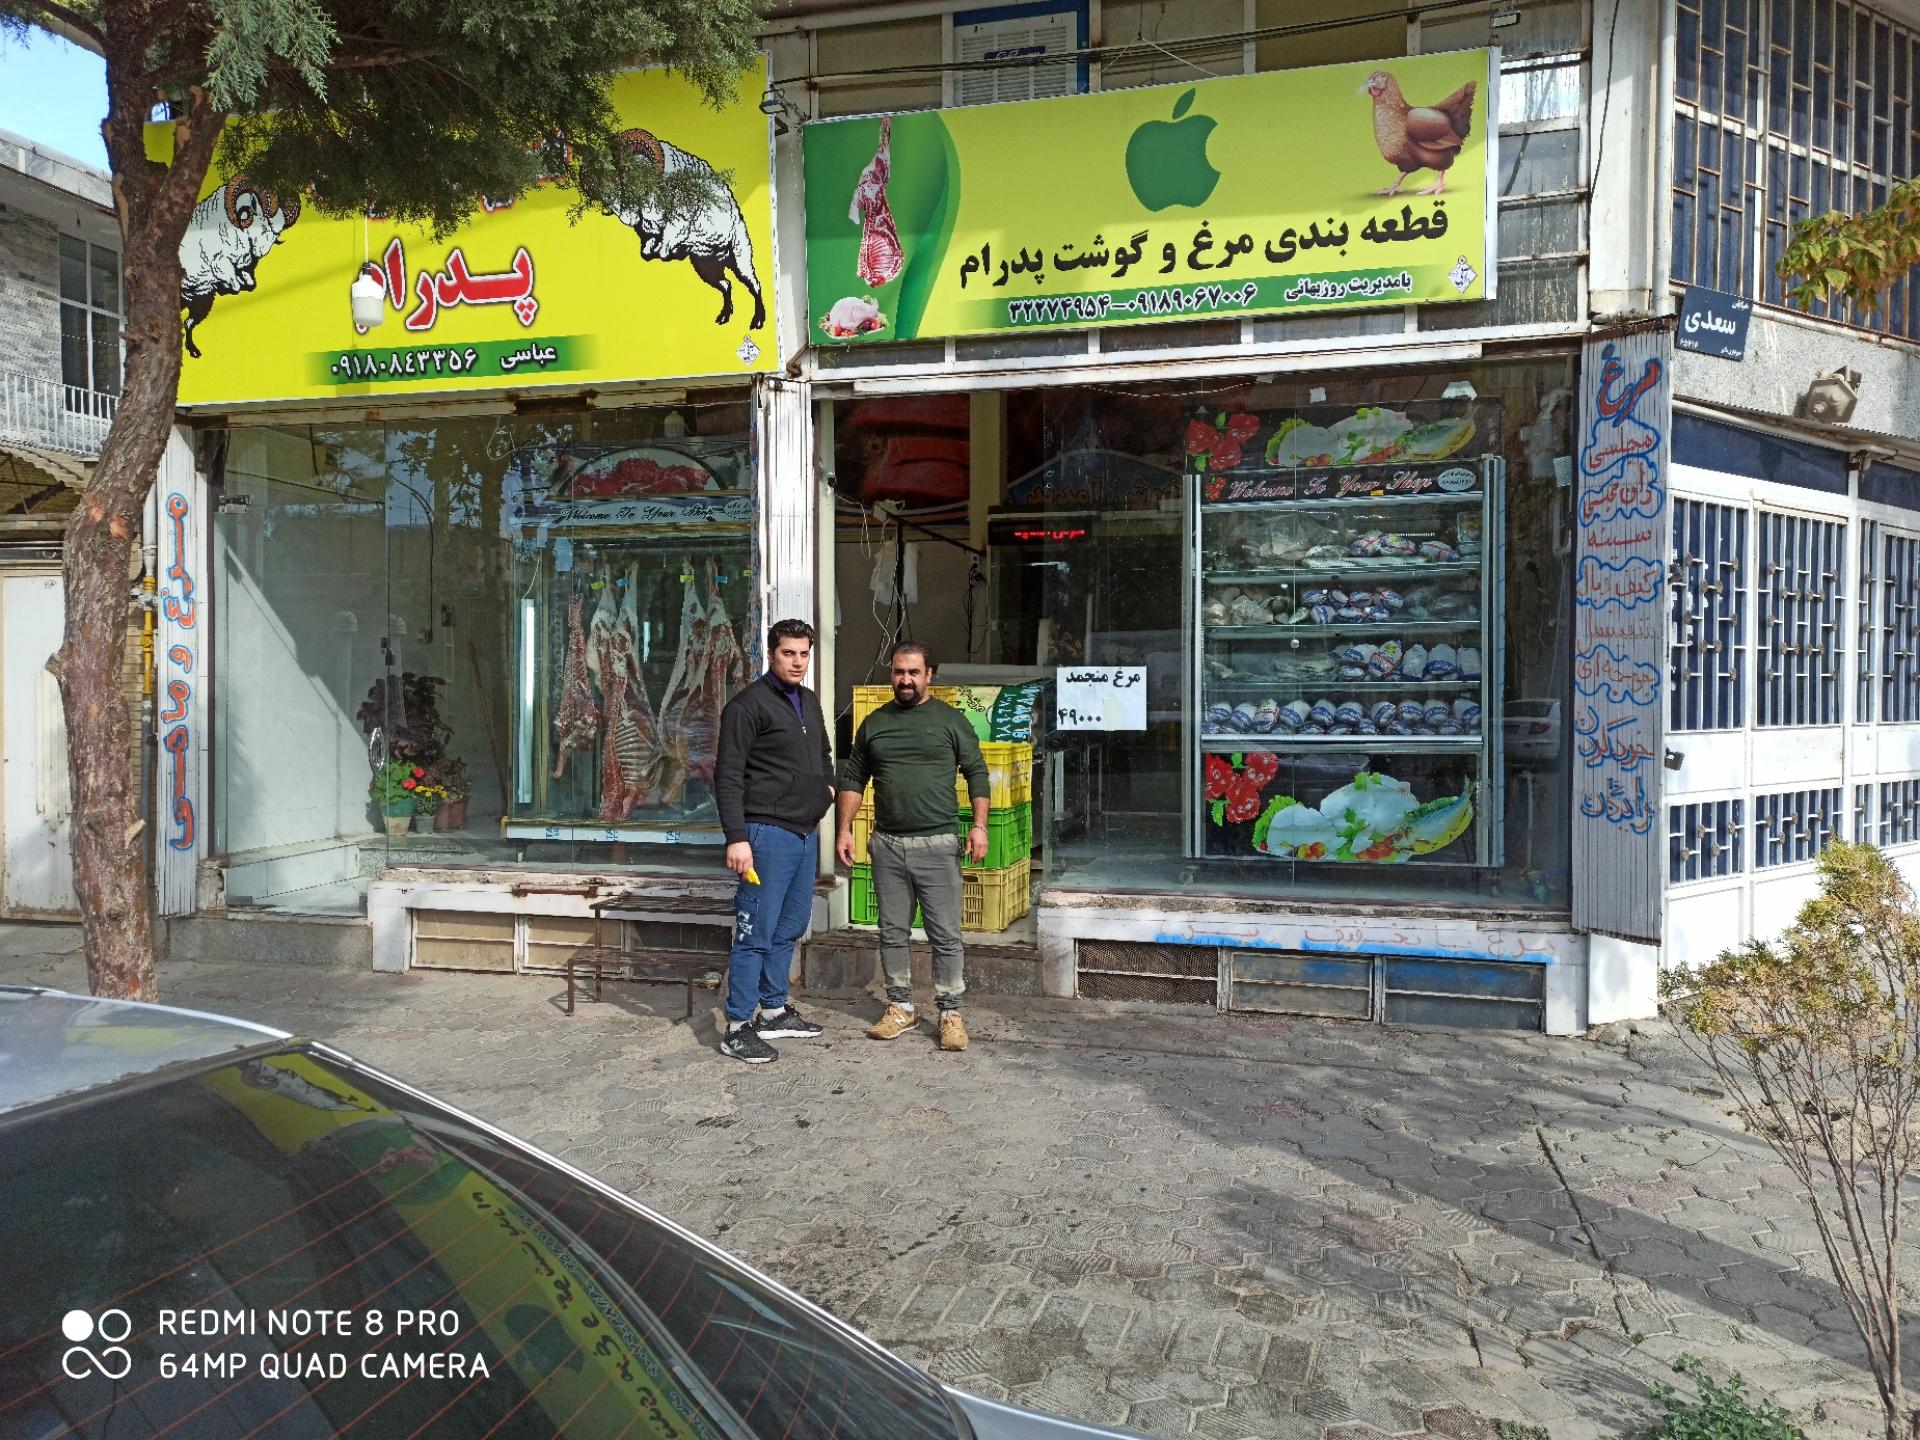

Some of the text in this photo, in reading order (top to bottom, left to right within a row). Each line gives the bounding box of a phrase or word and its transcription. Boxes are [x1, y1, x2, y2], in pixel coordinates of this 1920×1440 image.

[960, 200, 1448, 289] قطعه بندی مرغ و گوشت پدرام
[1685, 310, 1736, 335] سعدی
[500, 343, 557, 369] عباسی
[1596, 343, 1662, 428] مرغ
[560, 507, 610, 521] Welcome
[616, 506, 636, 519] To
[642, 506, 676, 521] Your
[682, 504, 713, 519] Shop
[1066, 667, 1140, 688] مرغ منجمد
[1058, 708, 1102, 725] ۴۹۰۰۰
